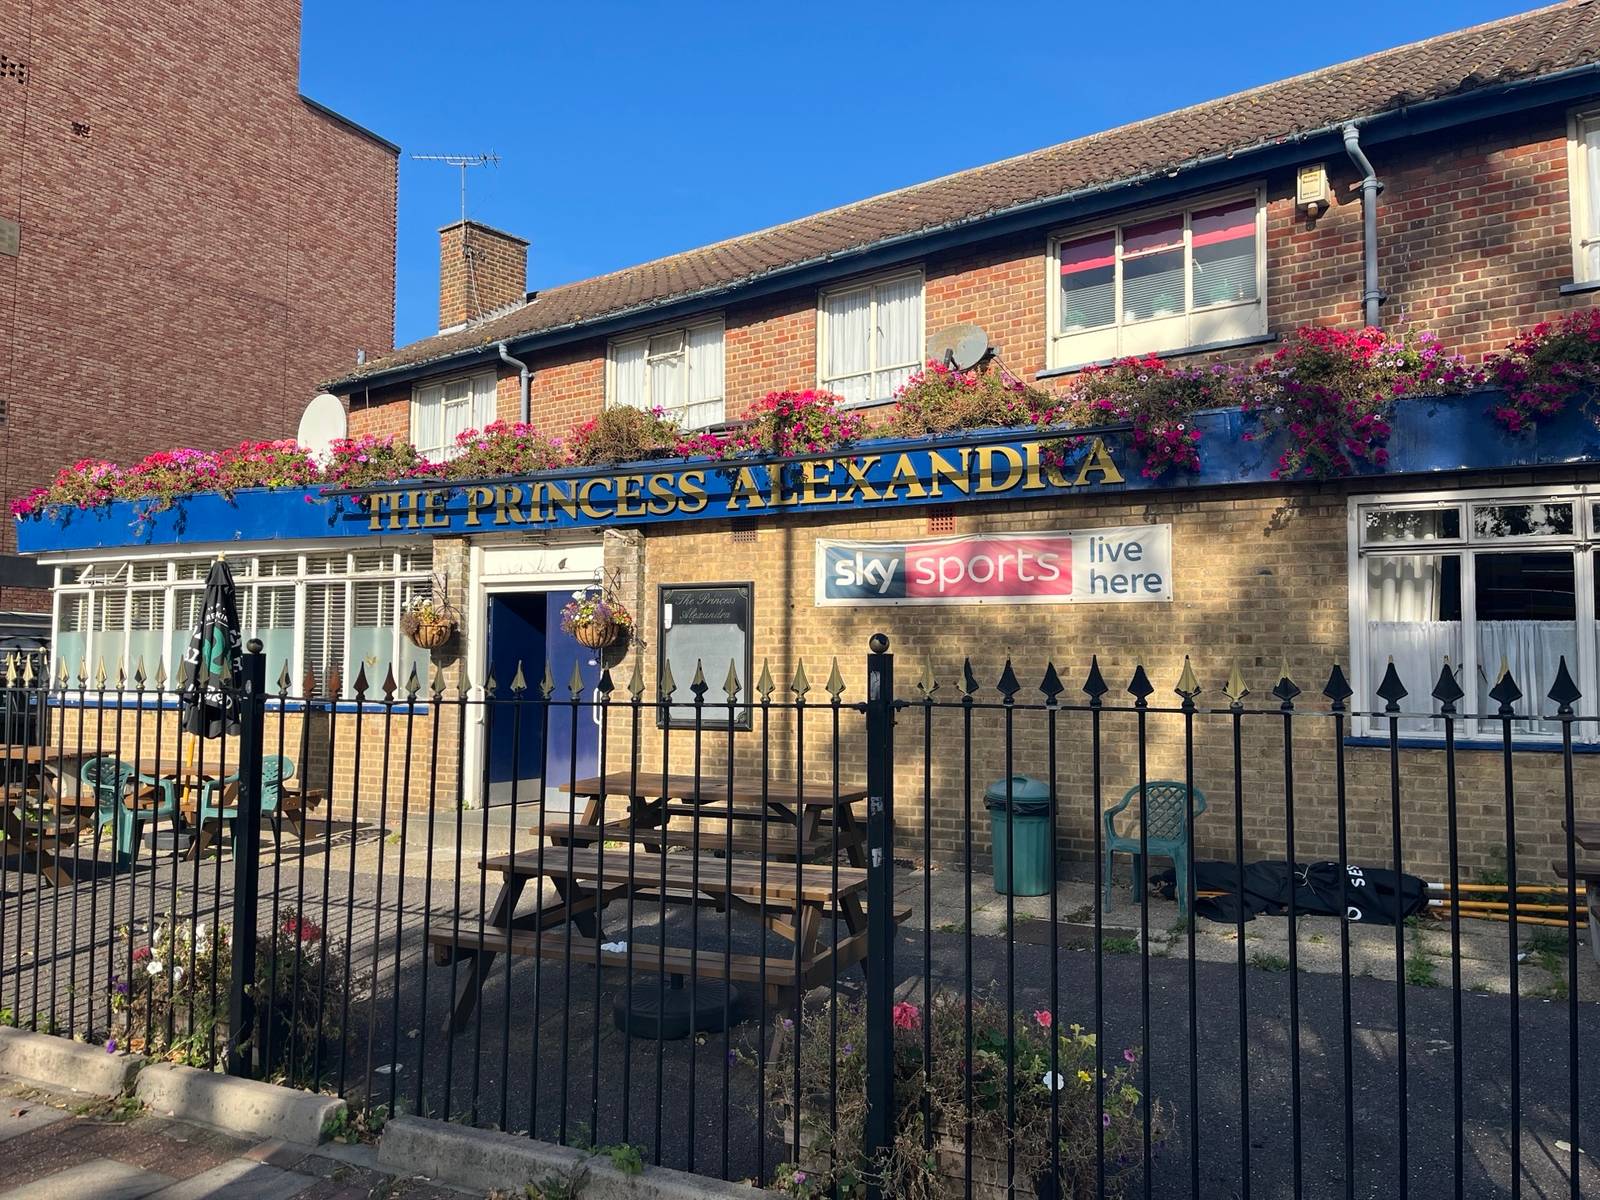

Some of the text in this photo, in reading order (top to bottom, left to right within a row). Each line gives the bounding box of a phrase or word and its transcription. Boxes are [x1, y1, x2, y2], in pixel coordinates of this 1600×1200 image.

[367, 491, 451, 531] THE
[464, 471, 708, 526] PRINCESS
[1089, 536, 1143, 563] live
[835, 547, 1061, 593] sky sports
[1089, 568, 1162, 594] here
[674, 592, 736, 605] The Princess
[679, 608, 731, 620] Alexandra
